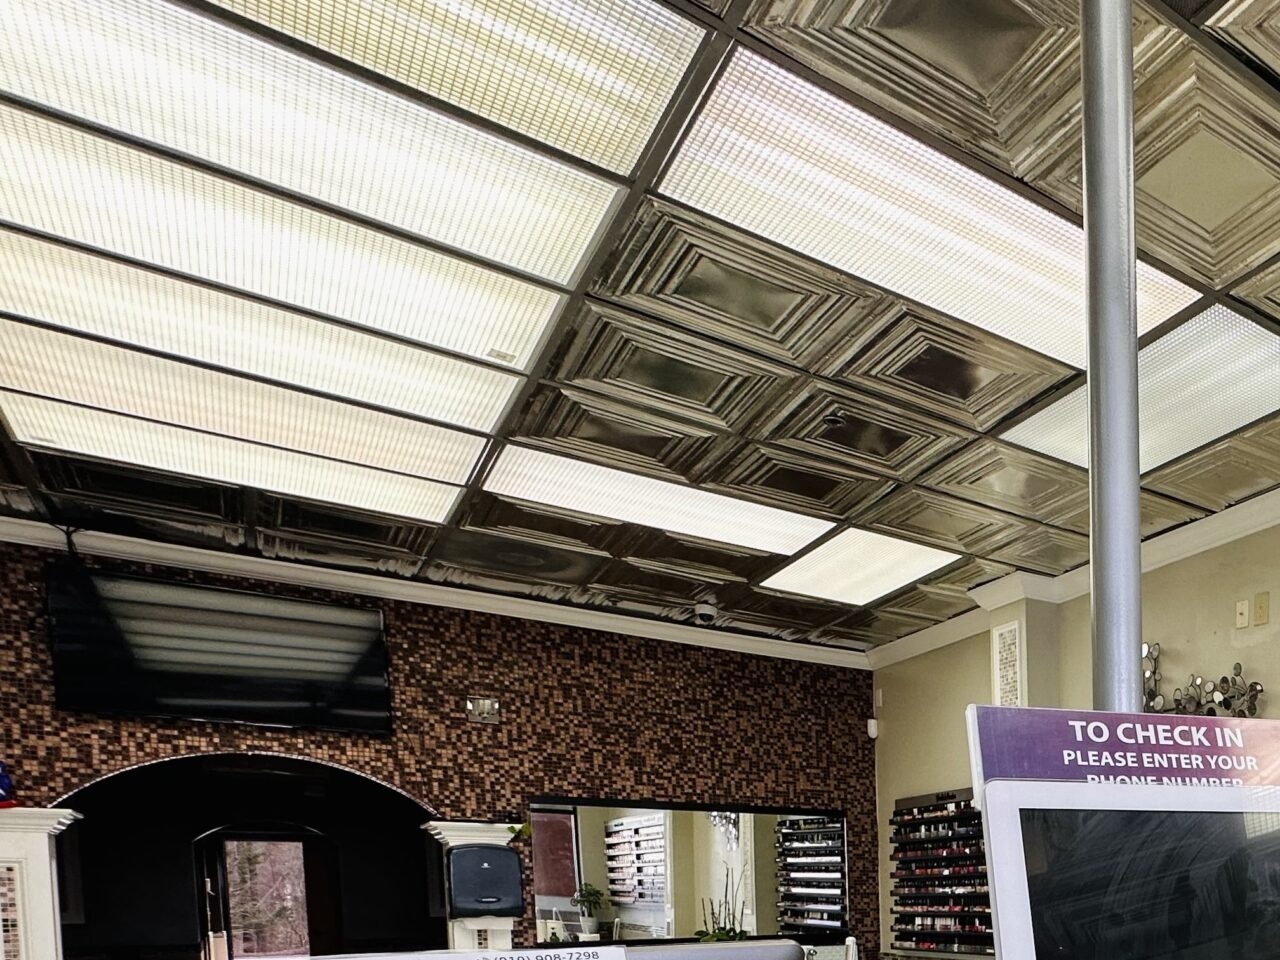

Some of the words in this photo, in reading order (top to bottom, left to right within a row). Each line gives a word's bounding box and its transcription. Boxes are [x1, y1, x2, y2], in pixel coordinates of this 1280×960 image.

[1068, 720, 1110, 743] TO
[1116, 723, 1211, 747] CHECK
[1215, 727, 1244, 748] IN
[1063, 750, 1138, 767] PLEASE
[1143, 752, 1204, 769] ENTER
[1205, 754, 1259, 771] YOUR
